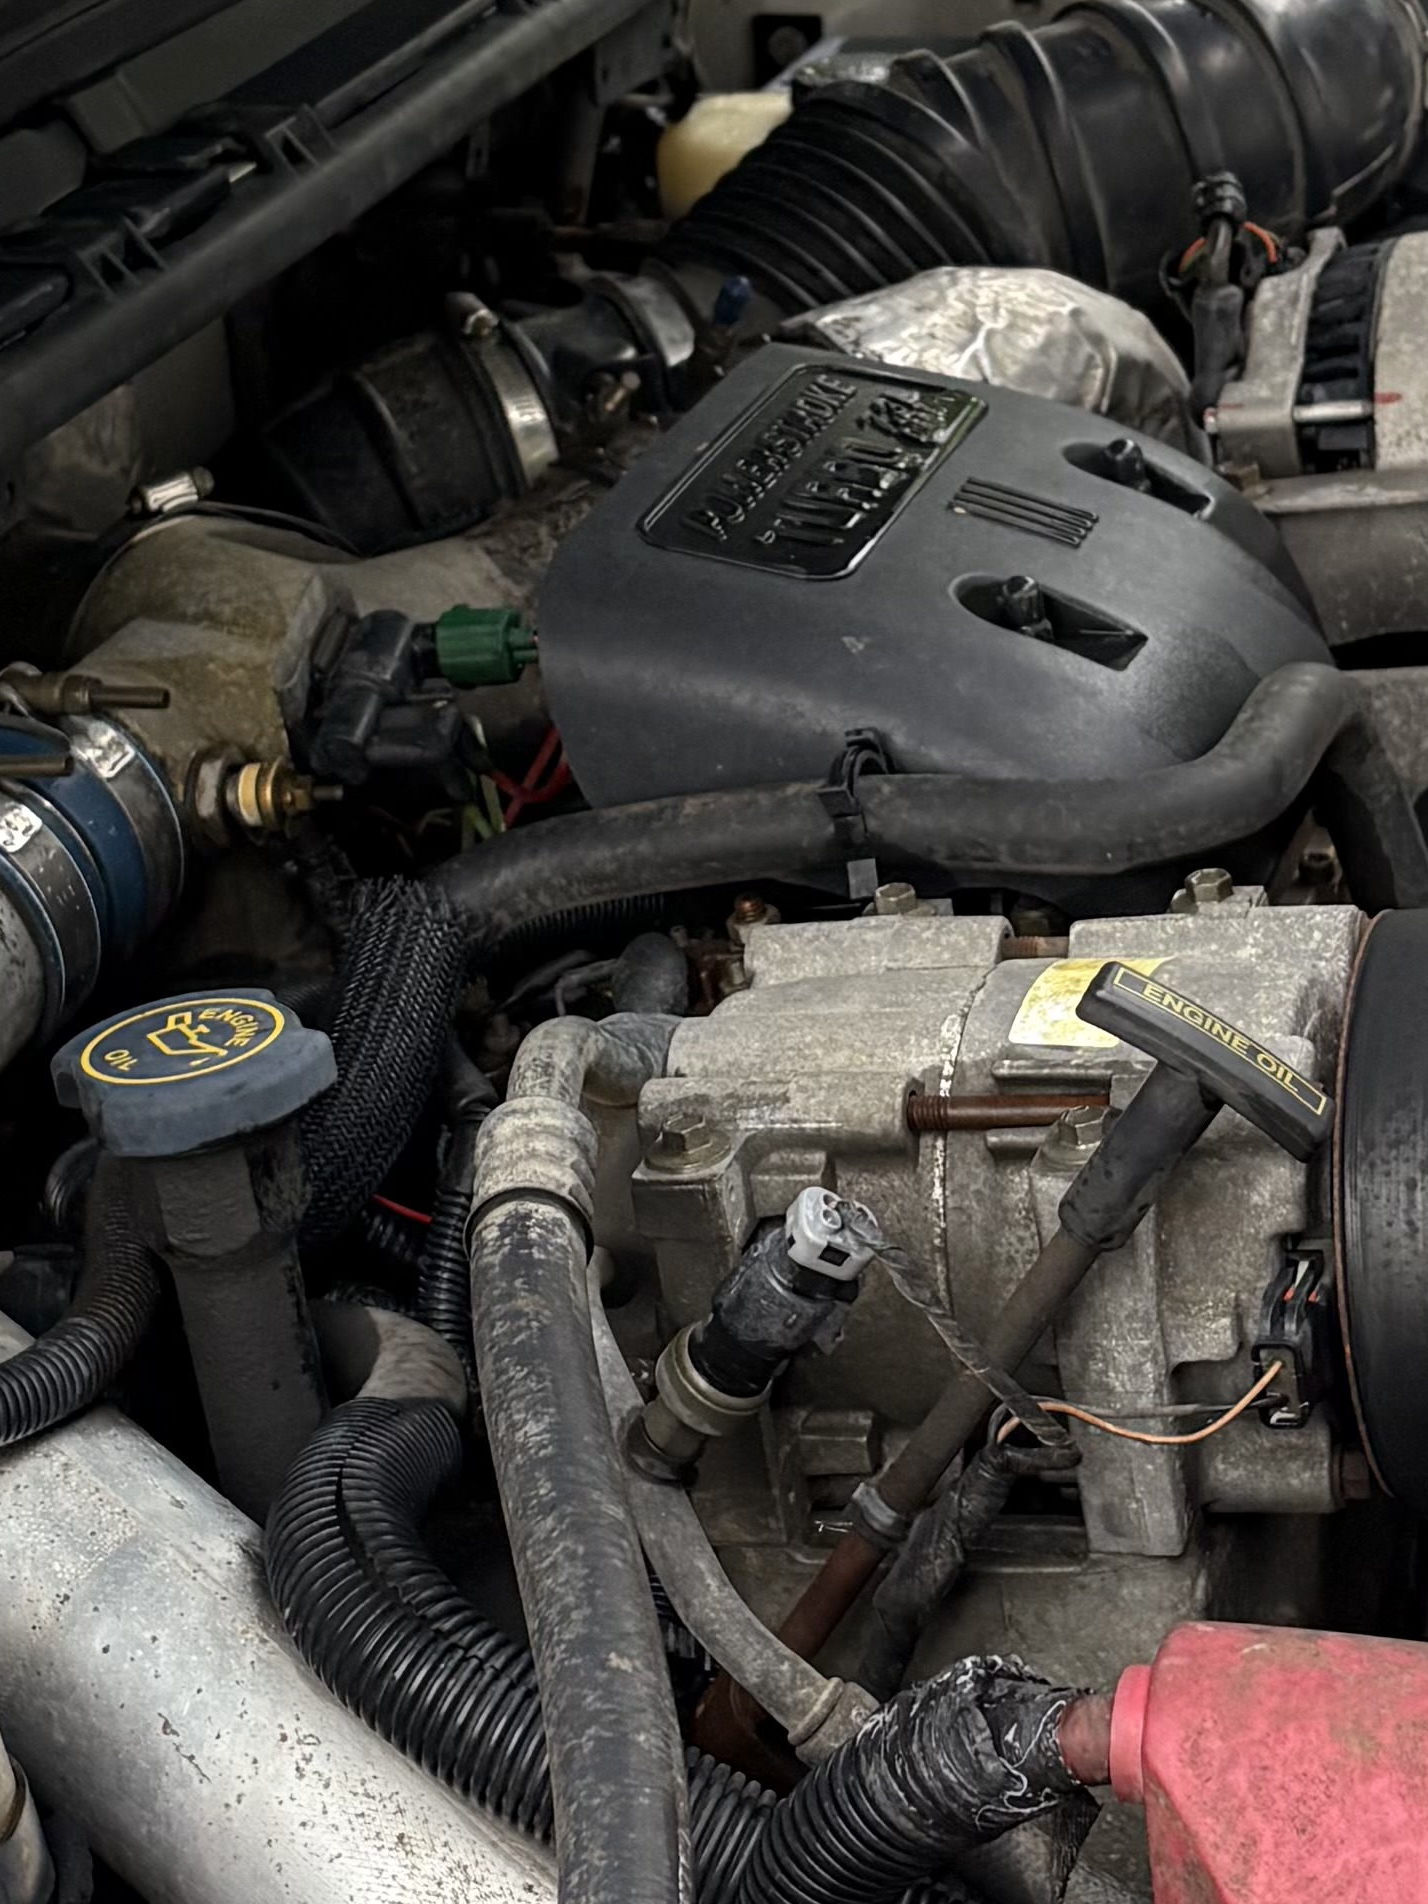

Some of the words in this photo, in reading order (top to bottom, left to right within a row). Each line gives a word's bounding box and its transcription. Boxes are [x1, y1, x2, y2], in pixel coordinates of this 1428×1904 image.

[198, 1007, 260, 1046] ENGINE
[1142, 984, 1251, 1054] ENGINE
[1256, 1053, 1299, 1092] OIL
[104, 1049, 138, 1072] OIL
